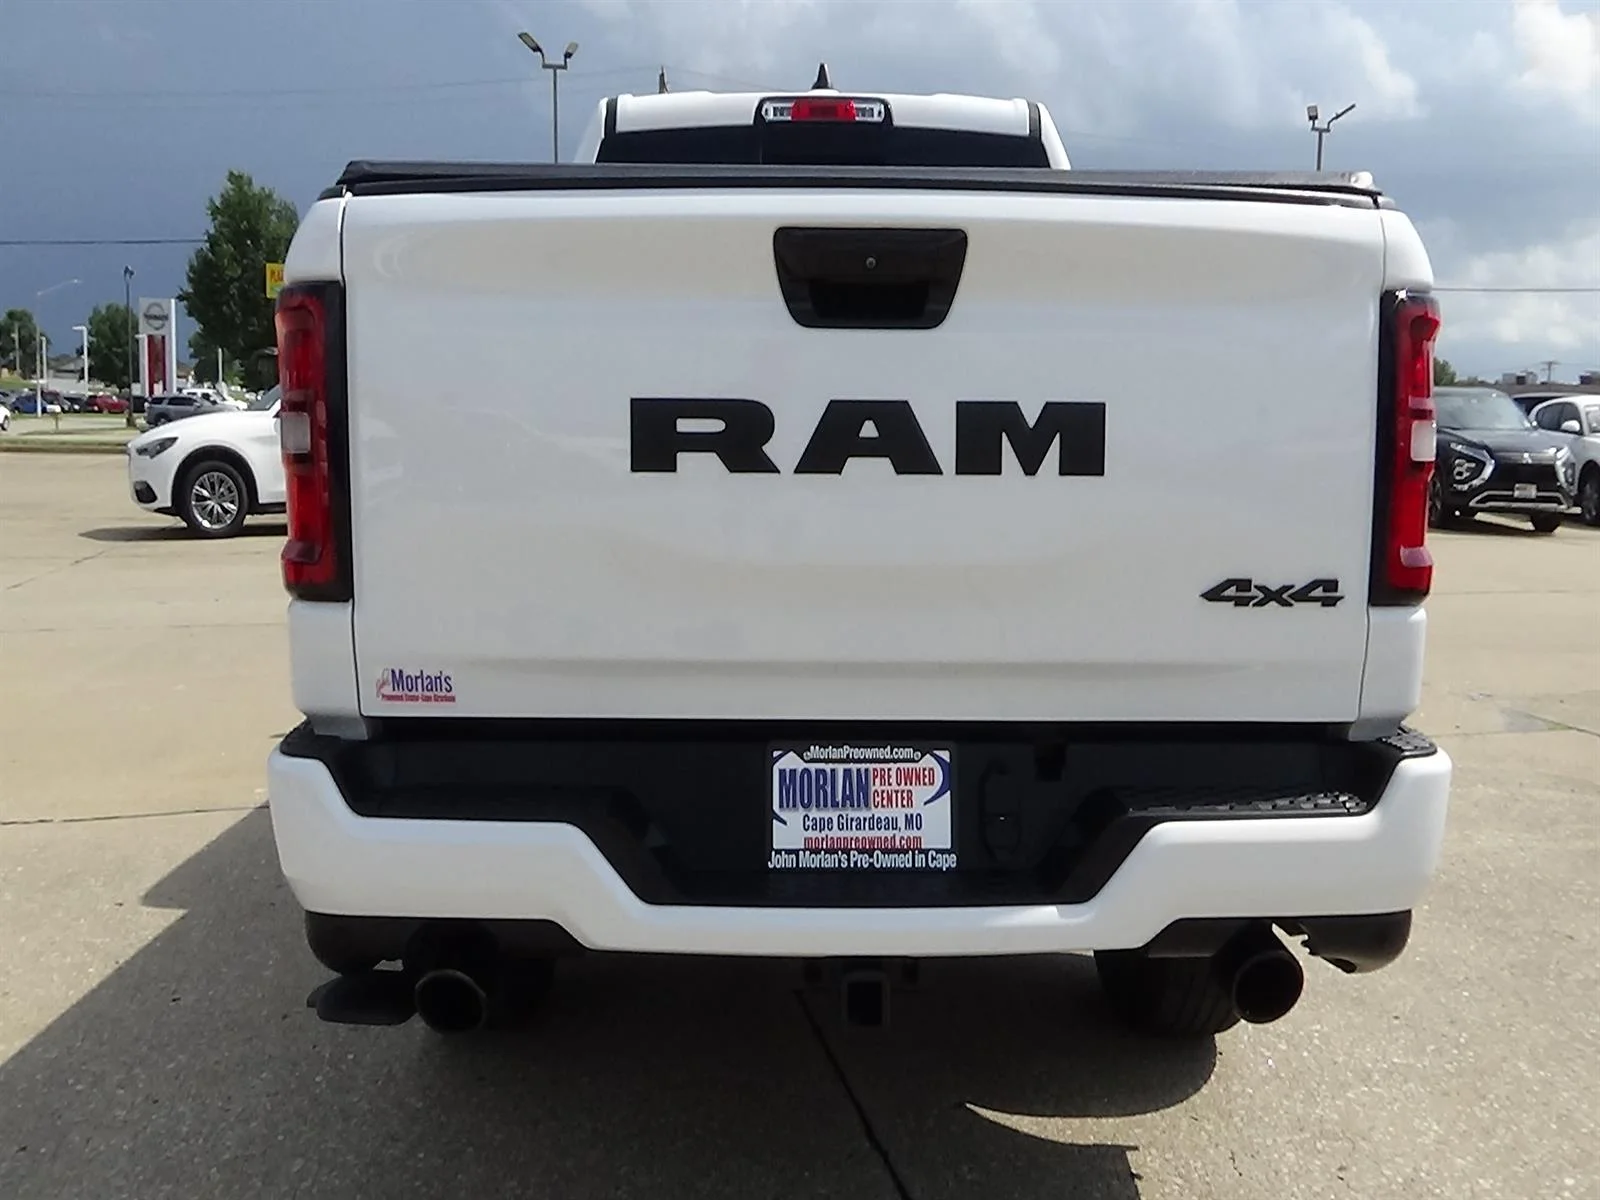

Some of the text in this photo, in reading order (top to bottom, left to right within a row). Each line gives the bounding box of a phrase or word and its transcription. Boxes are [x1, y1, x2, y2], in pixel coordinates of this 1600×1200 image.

[630, 397, 1106, 476] RAM
[1199, 578, 1345, 607] 4x4
[391, 668, 453, 693] Morlan's
[810, 745, 914, 760] MorlanPreowned.com
[872, 767, 935, 786] PRE OWNED
[778, 768, 869, 809] MORLAN
[872, 789, 913, 809] CENTER
[802, 813, 923, 833] Cape Girardeau, MO
[768, 850, 957, 871] John Morlan's Pre-Owned in Cape
